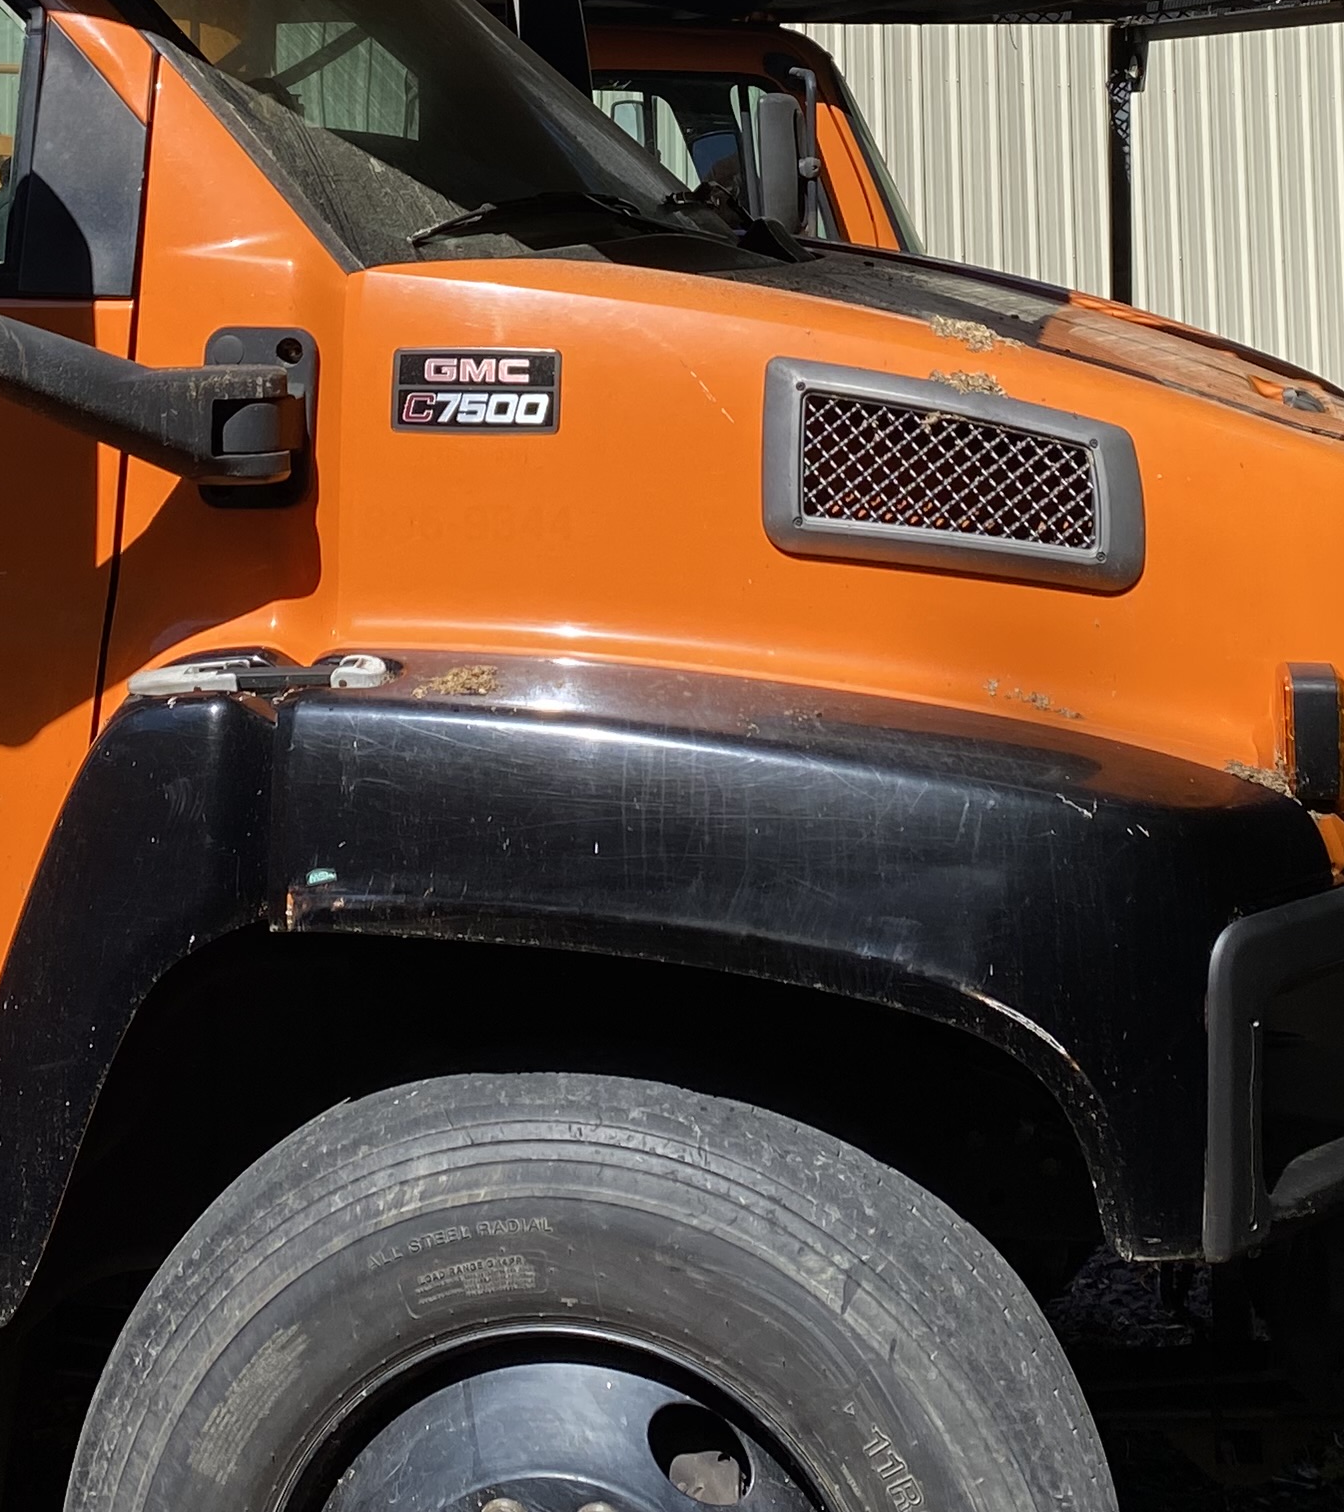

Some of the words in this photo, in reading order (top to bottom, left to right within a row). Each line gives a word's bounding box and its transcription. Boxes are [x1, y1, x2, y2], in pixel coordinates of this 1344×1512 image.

[424, 357, 530, 384] GMC
[402, 392, 550, 425] C7500
[367, 1246, 404, 1270] ALL
[408, 1226, 472, 1254] STEEL
[476, 1216, 554, 1237] RADIAL
[417, 1270, 446, 1285] LOAD
[449, 1260, 484, 1277] RANGE
